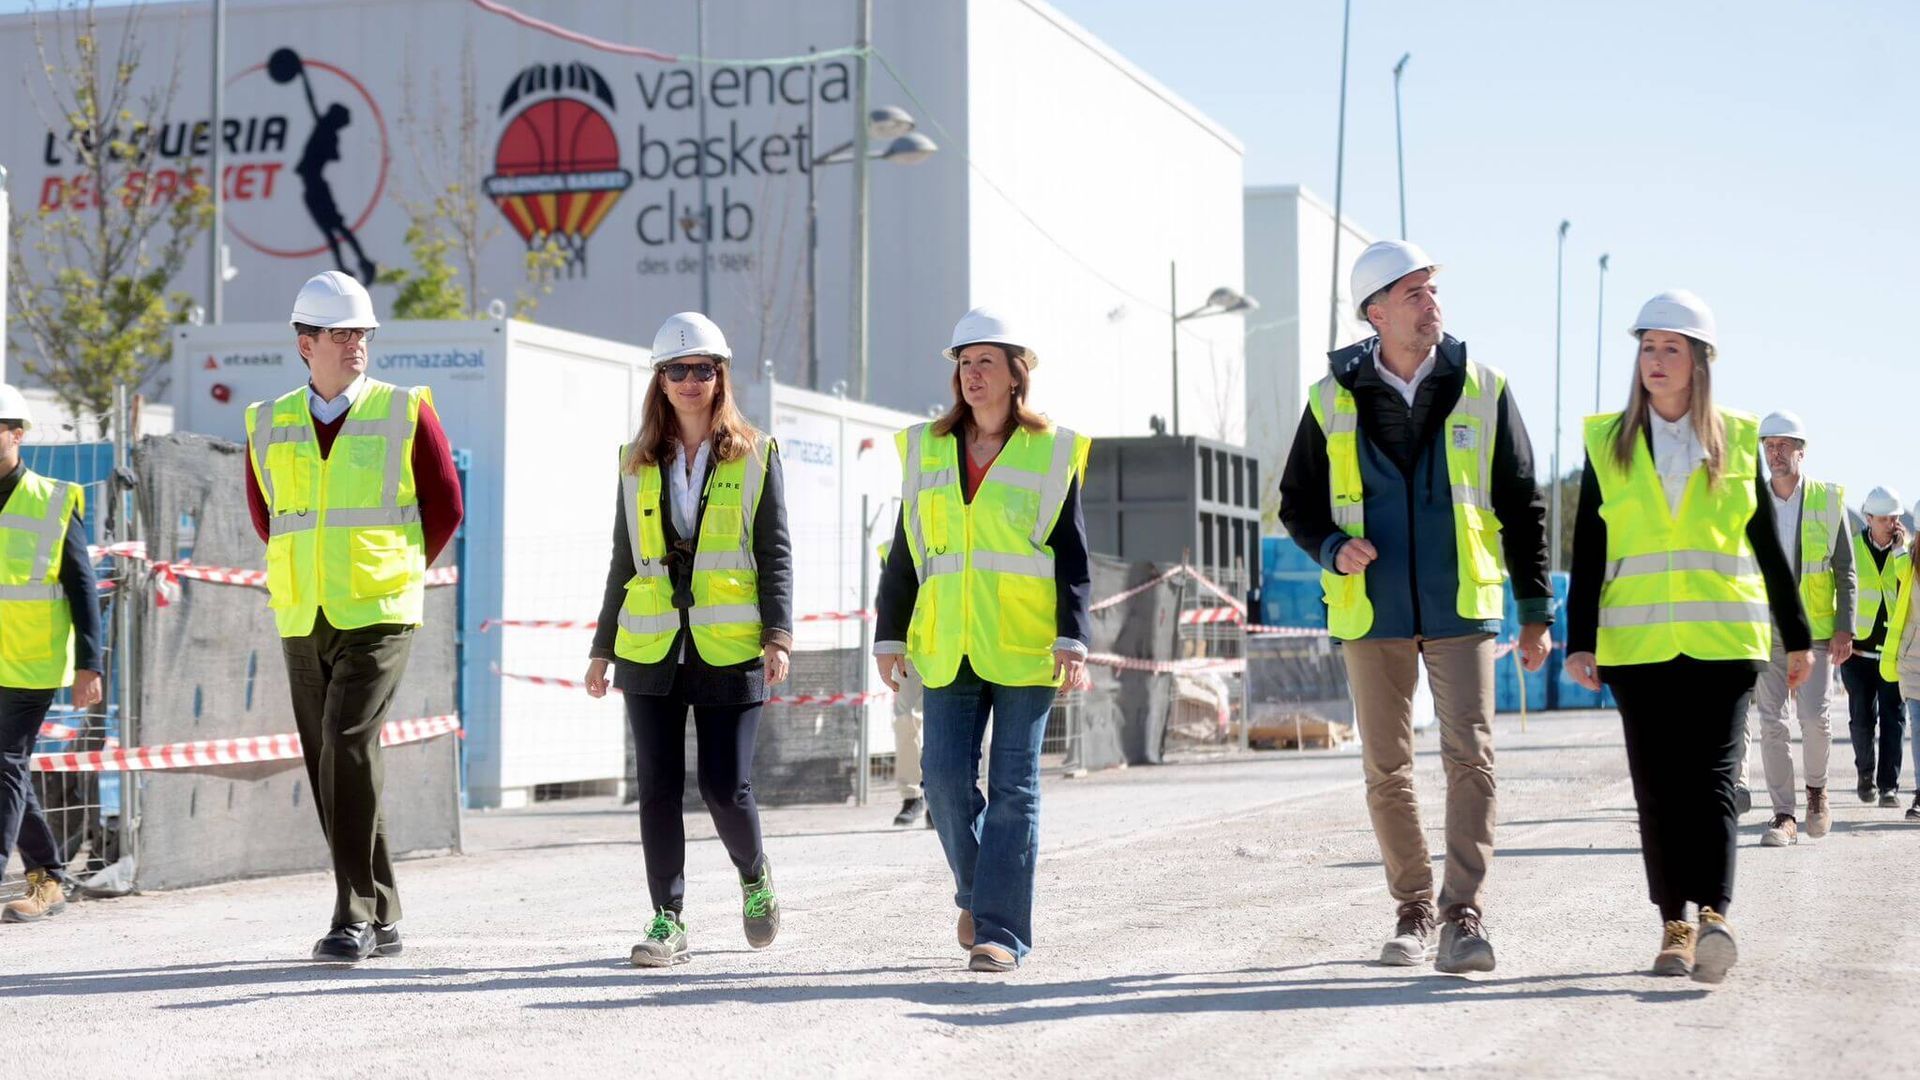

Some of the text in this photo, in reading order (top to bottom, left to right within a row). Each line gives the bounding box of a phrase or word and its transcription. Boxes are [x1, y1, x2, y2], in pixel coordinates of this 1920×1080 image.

[636, 60, 850, 111] vaenca
[639, 118, 811, 181] basket
[636, 186, 754, 247] club
[376, 348, 485, 369] ormazabal
